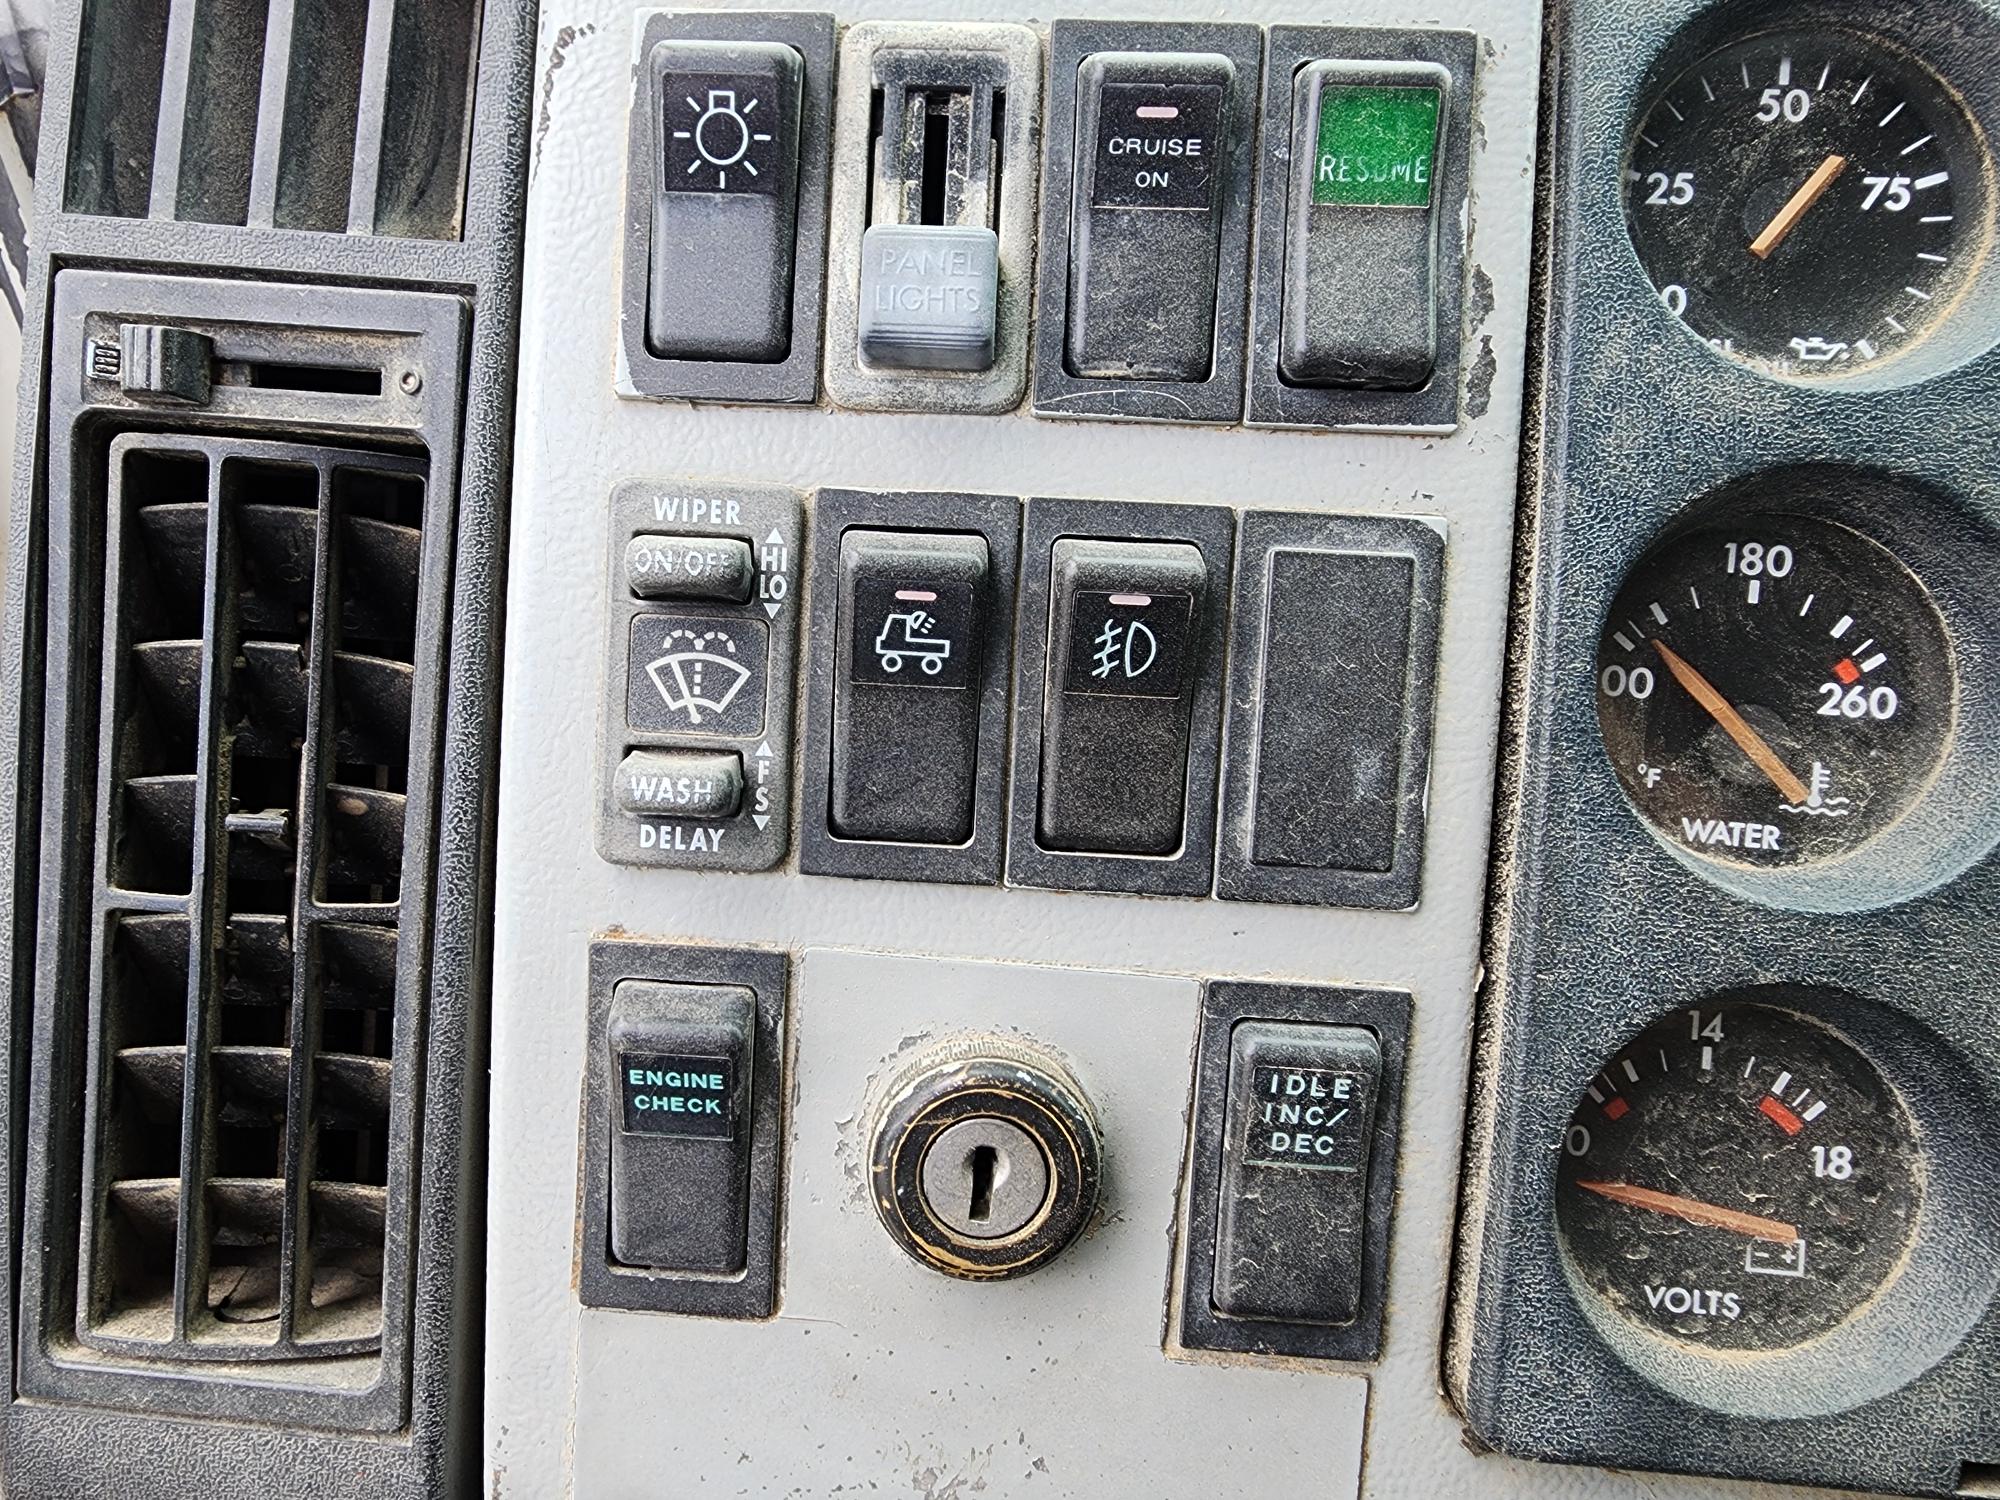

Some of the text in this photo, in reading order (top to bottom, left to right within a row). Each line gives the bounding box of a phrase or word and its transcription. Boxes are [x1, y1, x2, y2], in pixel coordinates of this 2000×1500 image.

[1756, 88, 1811, 122] 50
[1108, 137, 1202, 157] CRUISE
[1135, 171, 1169, 188] ON
[1319, 154, 1428, 183] RESUME
[1645, 172, 1695, 206] 25
[1861, 176, 1911, 212] 75
[881, 248, 983, 278] PANEL
[875, 284, 981, 314] LIGHTS
[1660, 284, 1687, 317] 0
[653, 496, 741, 525] WIPER
[760, 546, 788, 572] HI
[1724, 542, 1793, 578] 180
[759, 574, 788, 600] LO
[1601, 665, 1654, 699] 00
[1816, 682, 1897, 719] 260
[757, 760, 770, 784] F
[631, 776, 712, 804] WASH
[755, 787, 769, 812] S
[640, 824, 725, 852] DELAY
[1681, 817, 1780, 850] WATER
[1687, 1010, 1724, 1043] 14
[629, 1069, 724, 1090] ENGINE
[1270, 1074, 1352, 1100] IDLE
[634, 1095, 721, 1114] CHECK
[1265, 1104, 1349, 1127] INC/
[1271, 1132, 1334, 1155] DEC
[1566, 1125, 1590, 1157] 0
[1811, 1145, 1852, 1180] 18
[1644, 1285, 1741, 1319] VOLTS
